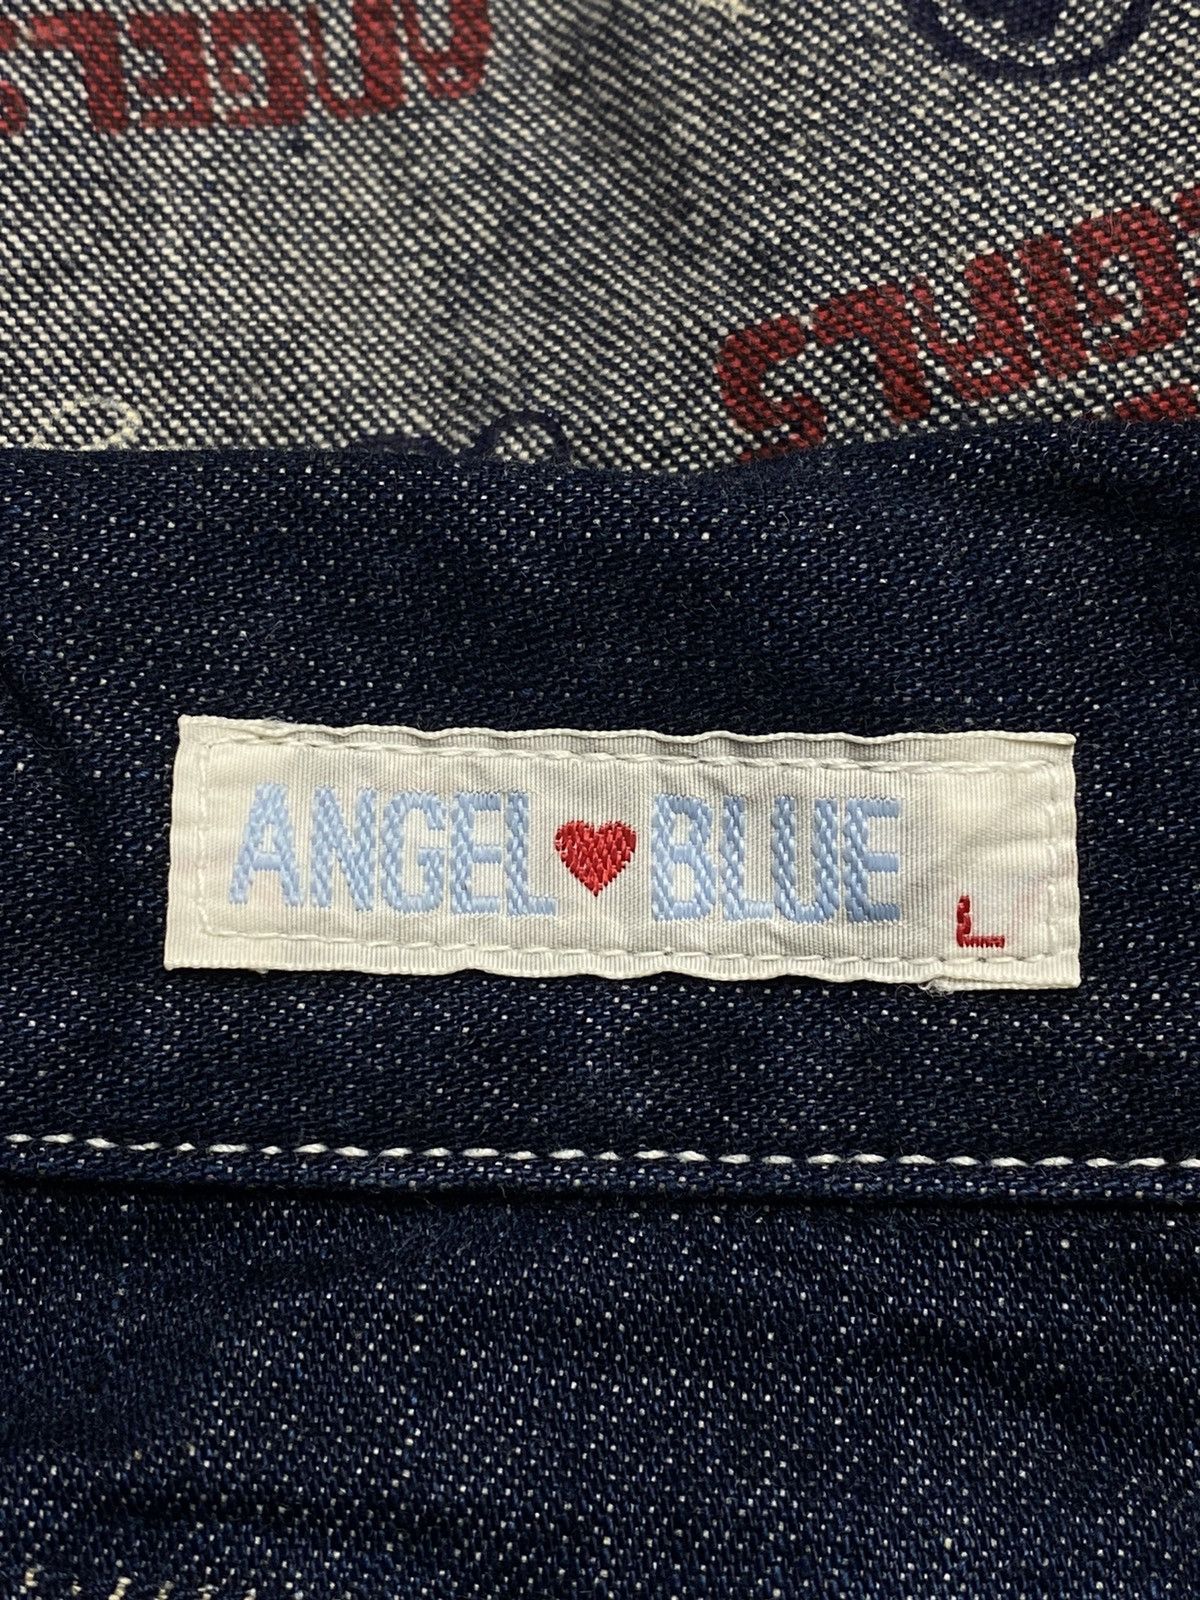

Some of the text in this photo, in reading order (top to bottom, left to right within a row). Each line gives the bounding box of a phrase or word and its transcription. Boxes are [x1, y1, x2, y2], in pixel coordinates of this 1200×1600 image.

[228, 782, 900, 924] ANGEL BLUE
[956, 894, 1005, 949] L
